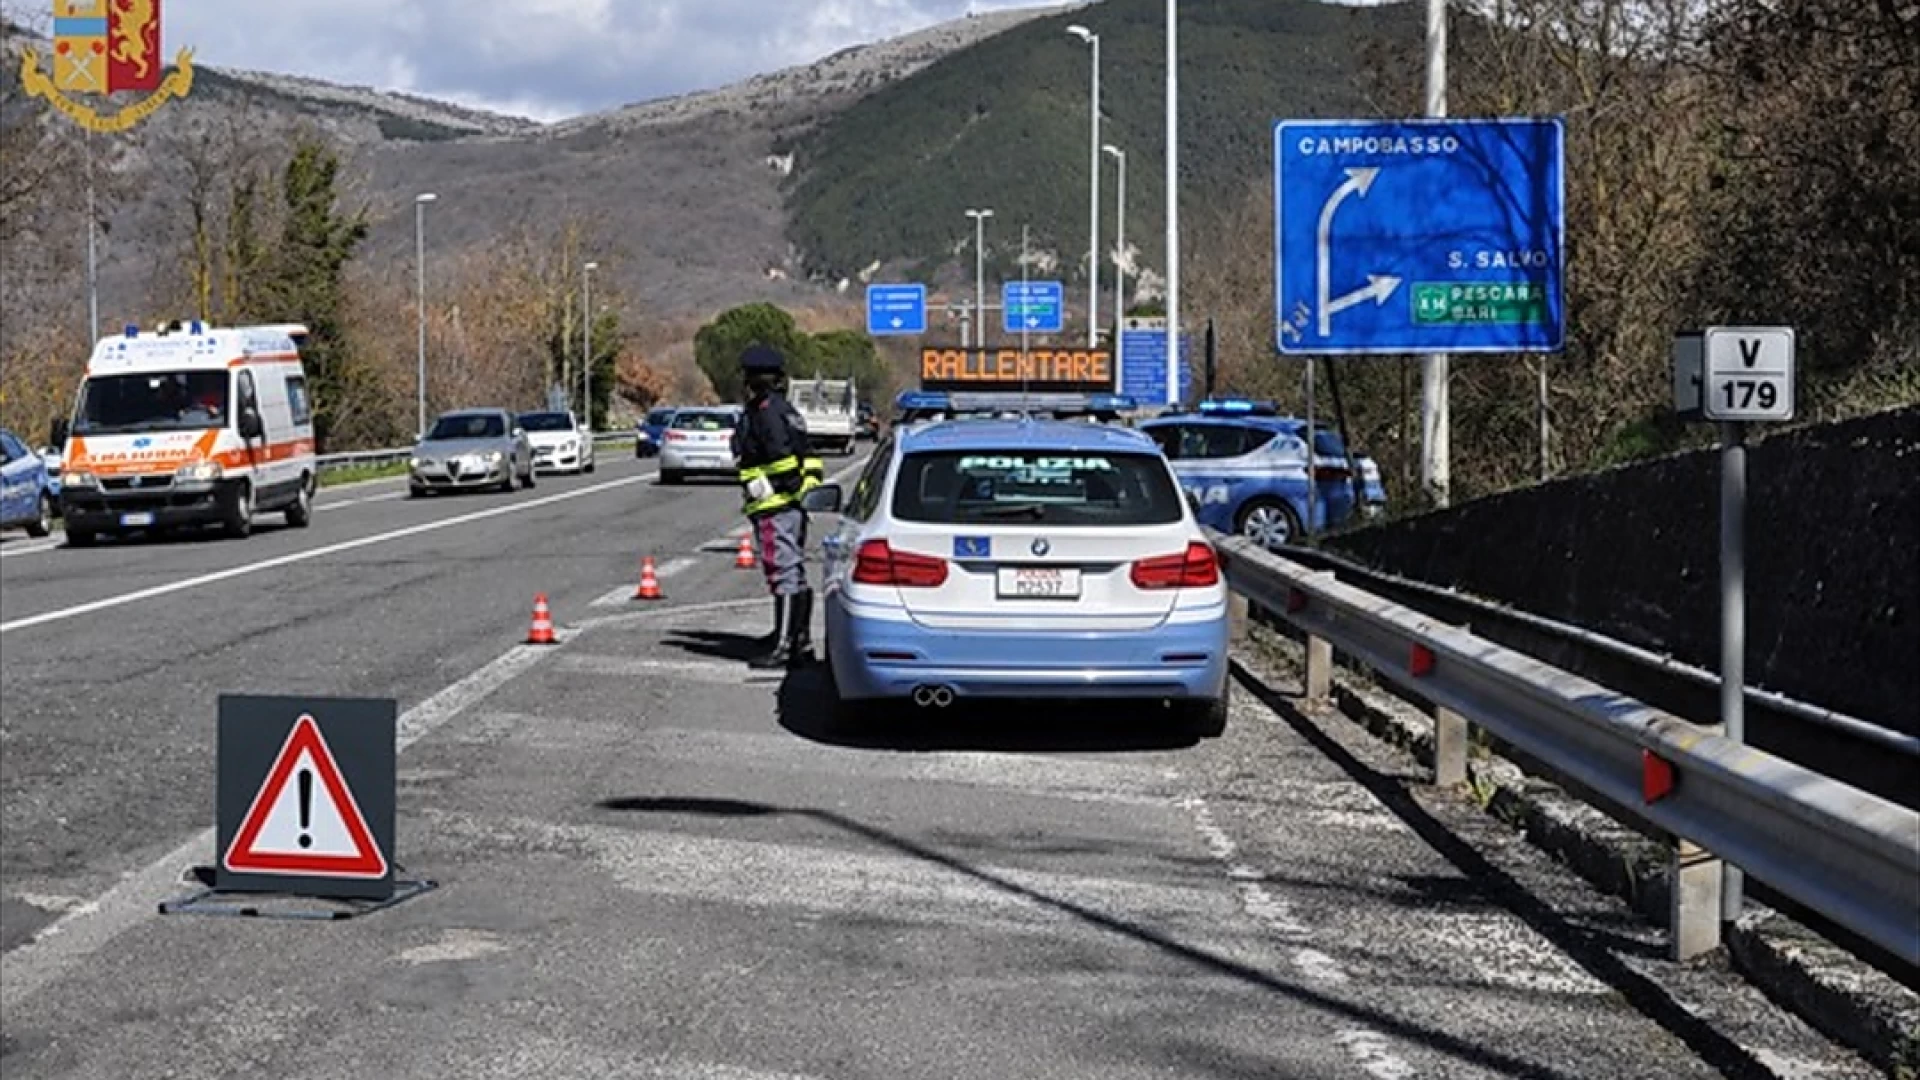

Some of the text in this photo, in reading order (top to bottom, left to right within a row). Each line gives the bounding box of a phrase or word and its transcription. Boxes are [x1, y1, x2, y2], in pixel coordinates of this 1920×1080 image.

[1298, 136, 1459, 154] CAMPOBASSO
[1448, 251, 1547, 268] S. SALVO
[1451, 286, 1543, 300] PESCARA
[1739, 338, 1761, 368] V
[922, 349, 1112, 382] RALLENTARE
[1722, 380, 1777, 409] 179
[957, 456, 1114, 471] POLIZIA
